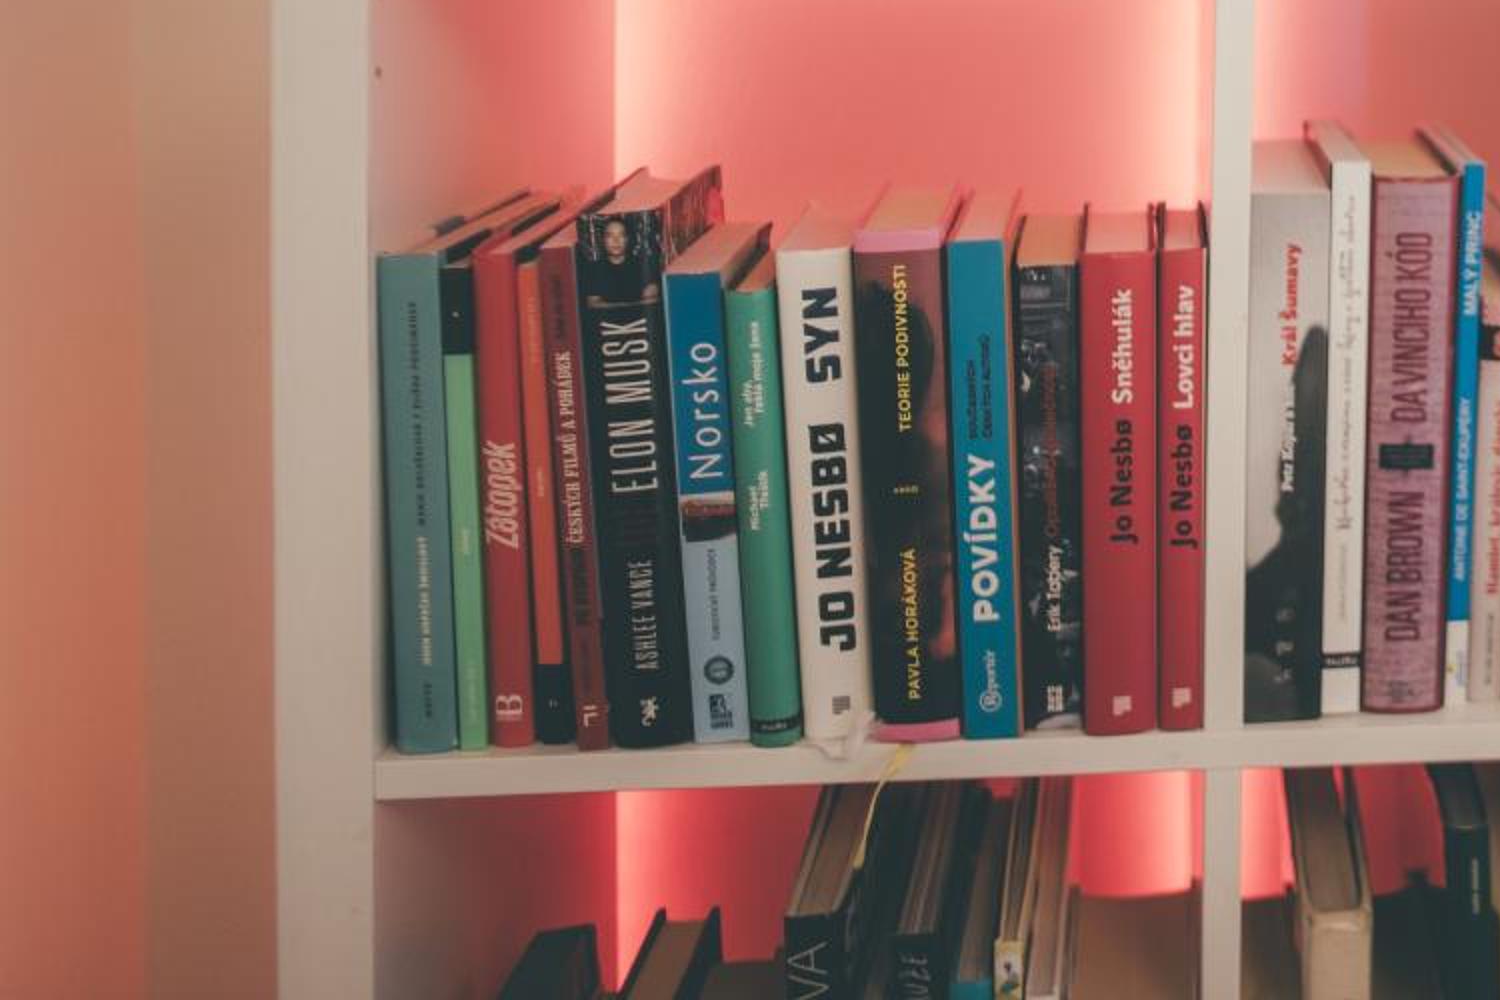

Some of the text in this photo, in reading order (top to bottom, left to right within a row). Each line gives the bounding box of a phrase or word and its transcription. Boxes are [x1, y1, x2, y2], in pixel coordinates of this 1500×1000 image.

[1280, 243, 1302, 321] Šumavy
[1387, 231, 1433, 280] KÓD
[1464, 211, 1482, 267] PRINC
[802, 286, 841, 384] SYN
[892, 264, 913, 433] TEORIE PODIVNOSTI
[1111, 289, 1133, 405] Sněhulák
[1172, 285, 1195, 409] Lovci hlav
[1281, 326, 1298, 367] Král
[560, 420, 576, 430] A
[600, 317, 659, 494] ELON MUSK
[681, 342, 723, 481] Norsko
[808, 422, 856, 652] JO NESBØ
[964, 454, 999, 622] POVÍDKY
[1109, 420, 1138, 545] Jo Nesbø
[1169, 424, 1198, 549] Jo Nesbø
[1386, 490, 1424, 586] BROWN
[627, 559, 659, 671] ASHLEE VANCE
[901, 548, 922, 700] PAVLA HORÁKOVÁ
[1046, 602, 1062, 632] Erik
[1385, 589, 1421, 642] DAN
